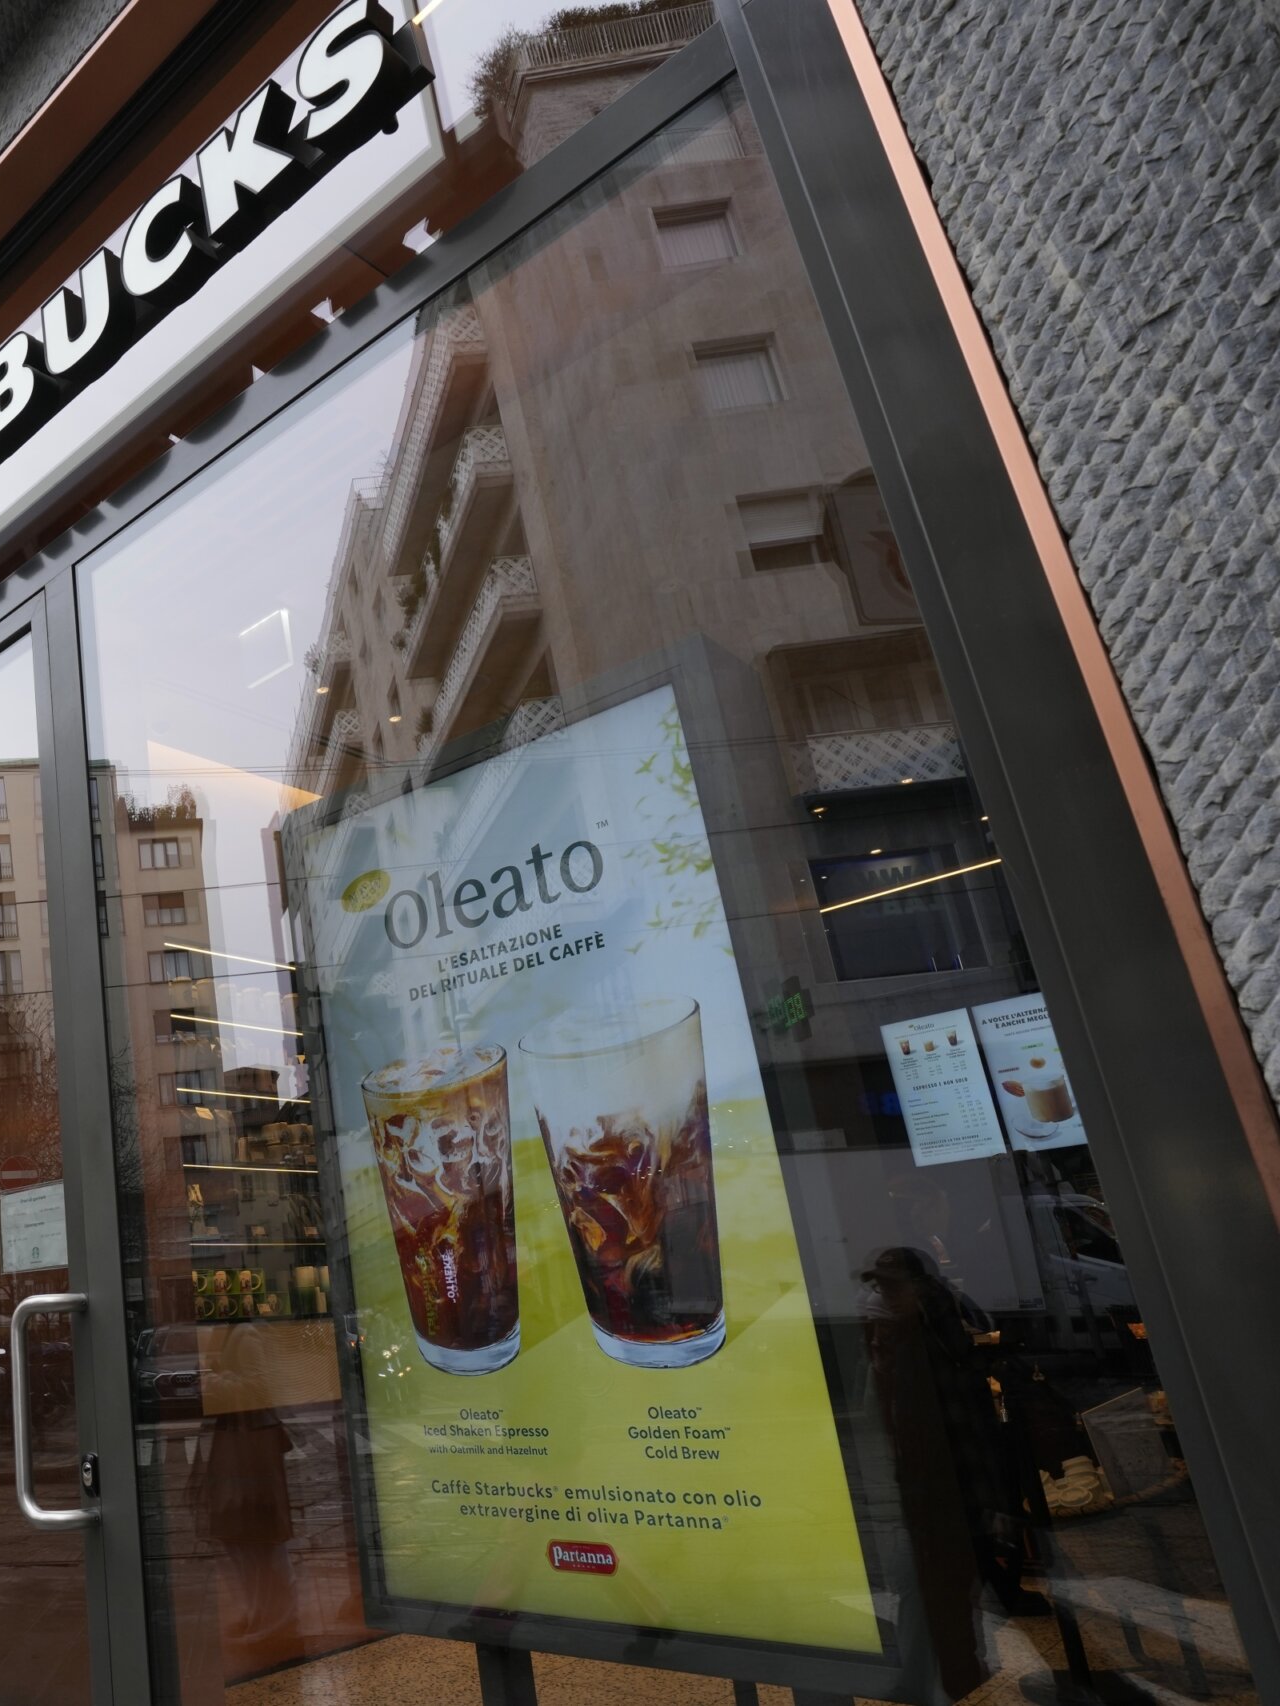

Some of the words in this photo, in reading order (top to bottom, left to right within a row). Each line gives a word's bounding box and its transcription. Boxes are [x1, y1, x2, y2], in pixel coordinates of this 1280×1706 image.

[437, 924, 563, 973] L'ESALTAZIONE
[409, 982, 437, 1001] DEL
[440, 961, 508, 993] RITUALE
[513, 952, 545, 972] DEL
[549, 931, 606, 962] CAFFÈ
[988, 1014, 1010, 1024] VOLTE
[1001, 1018, 1026, 1028] ANCHE
[424, 1424, 447, 1436] Iced
[449, 1424, 492, 1437] Shaken
[495, 1425, 549, 1439] Espresso
[628, 1426, 680, 1439] Golden
[450, 1445, 484, 1455] Oatmilk
[487, 1446, 504, 1455] and
[506, 1446, 548, 1456] Hazelnut
[645, 1446, 678, 1459] Cold
[681, 1446, 720, 1460] Brew
[431, 1480, 470, 1494] Caffè
[564, 1485, 676, 1504] emulsionato
[682, 1492, 717, 1506] con
[723, 1490, 762, 1508] olio
[460, 1504, 560, 1522] extravergine
[566, 1506, 582, 1522] di
[587, 1508, 628, 1524] oliva
[552, 1546, 614, 1566] Partanna
